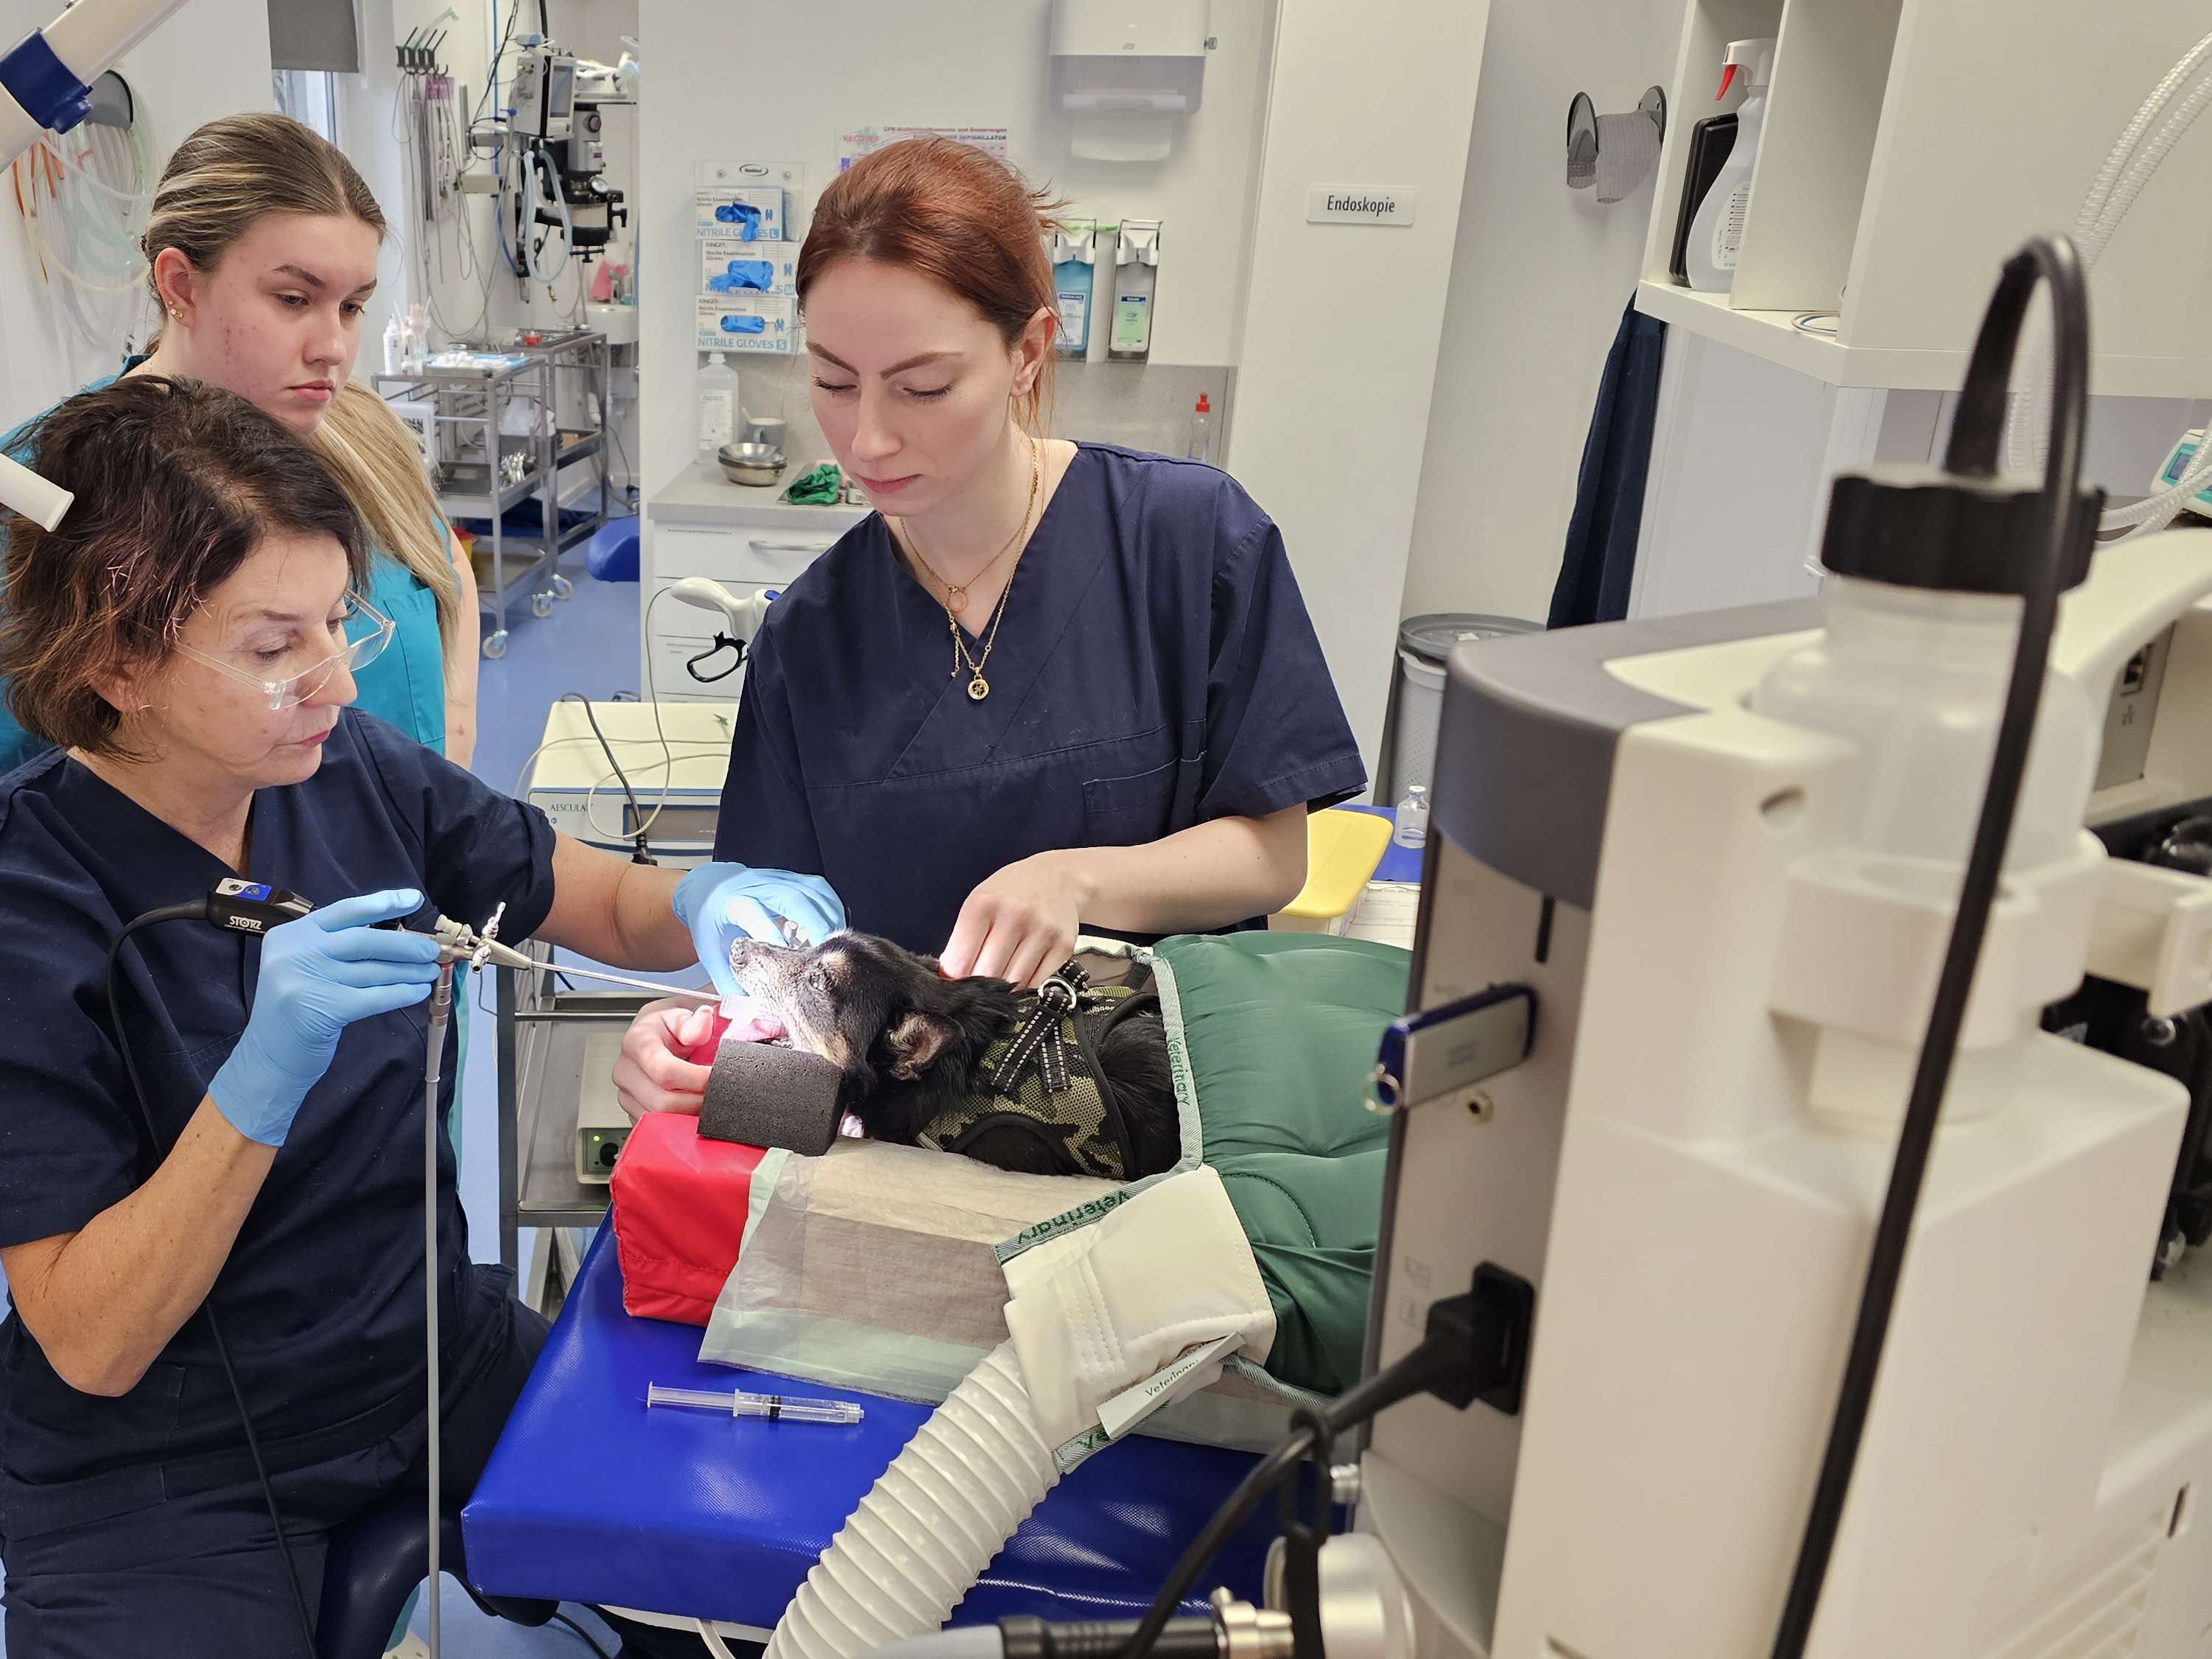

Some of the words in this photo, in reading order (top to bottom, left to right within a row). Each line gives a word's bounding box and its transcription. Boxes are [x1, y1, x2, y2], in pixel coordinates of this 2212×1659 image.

[1327, 195, 1395, 217] Endoskopie
[696, 228, 731, 236] NITRILE
[698, 337, 734, 347] NITRILE
[737, 339, 773, 348] GLOVES
[778, 340, 786, 349] S
[551, 803, 594, 812] AESCULA
[229, 915, 262, 930] STORZ
[1168, 1037, 1191, 1106] Veterinary
[1018, 1190, 1131, 1245] Veterinary
